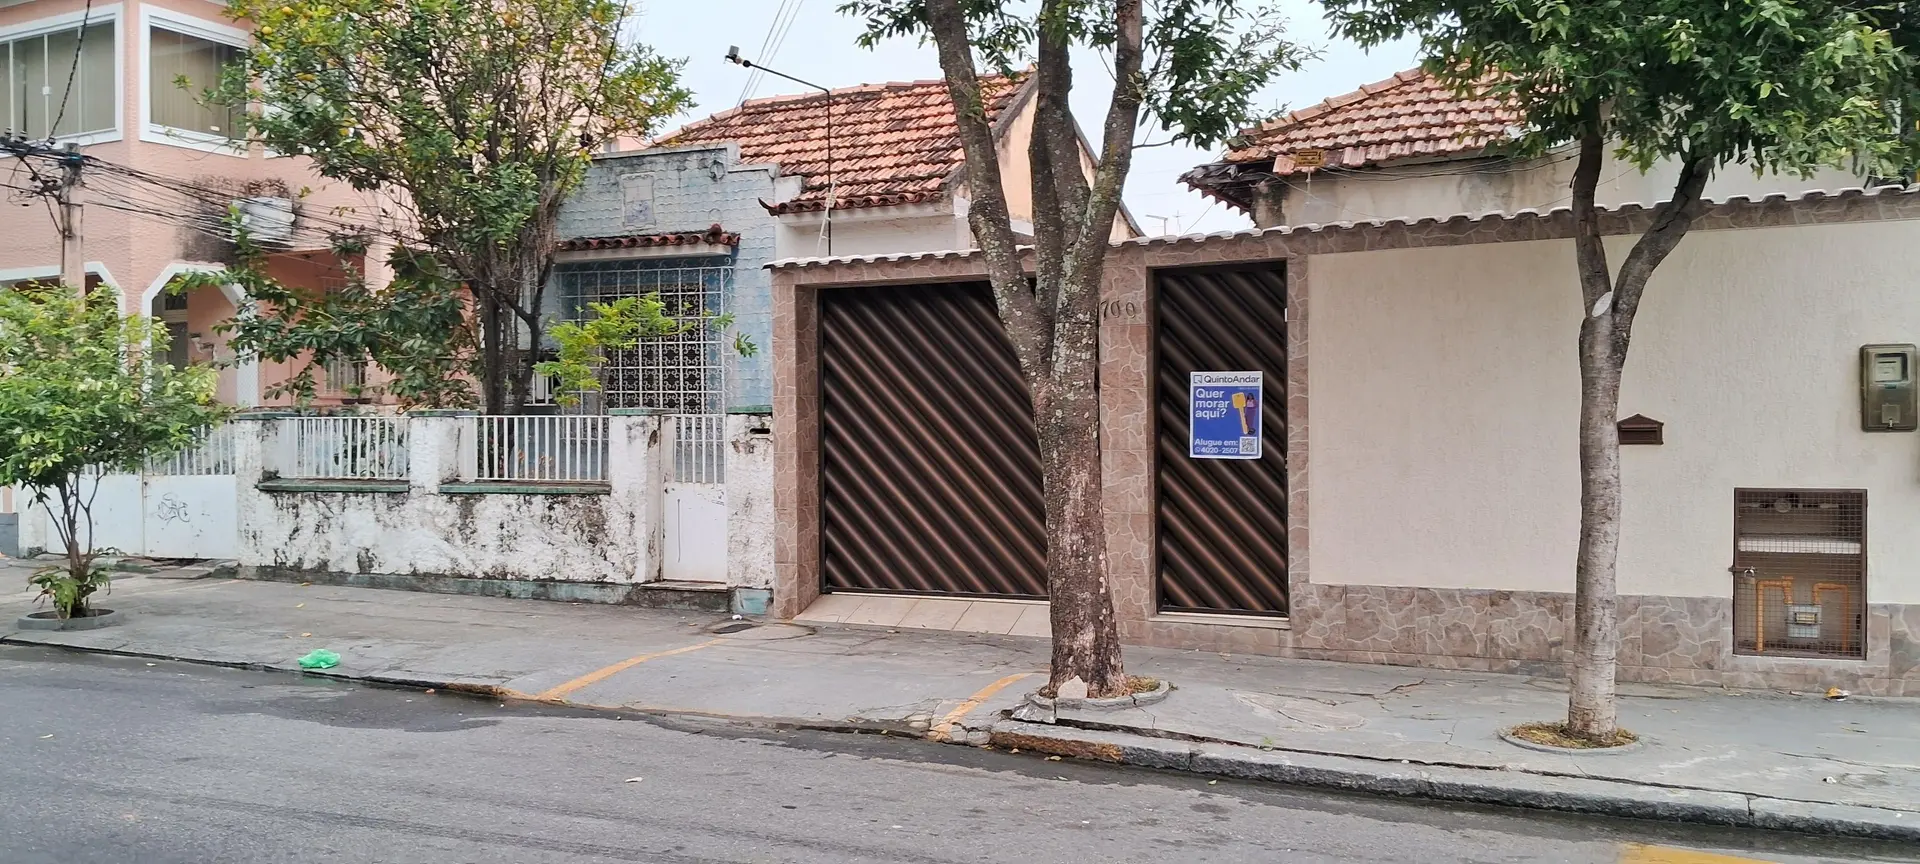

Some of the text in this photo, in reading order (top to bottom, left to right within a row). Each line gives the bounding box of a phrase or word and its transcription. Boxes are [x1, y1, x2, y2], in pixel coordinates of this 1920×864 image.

[1203, 375, 1260, 384] QuintoAndar
[1195, 388, 1225, 399] Quer
[1195, 400, 1230, 408] morar
[1195, 408, 1227, 420] aqui?
[1194, 438, 1223, 447] Alugue
